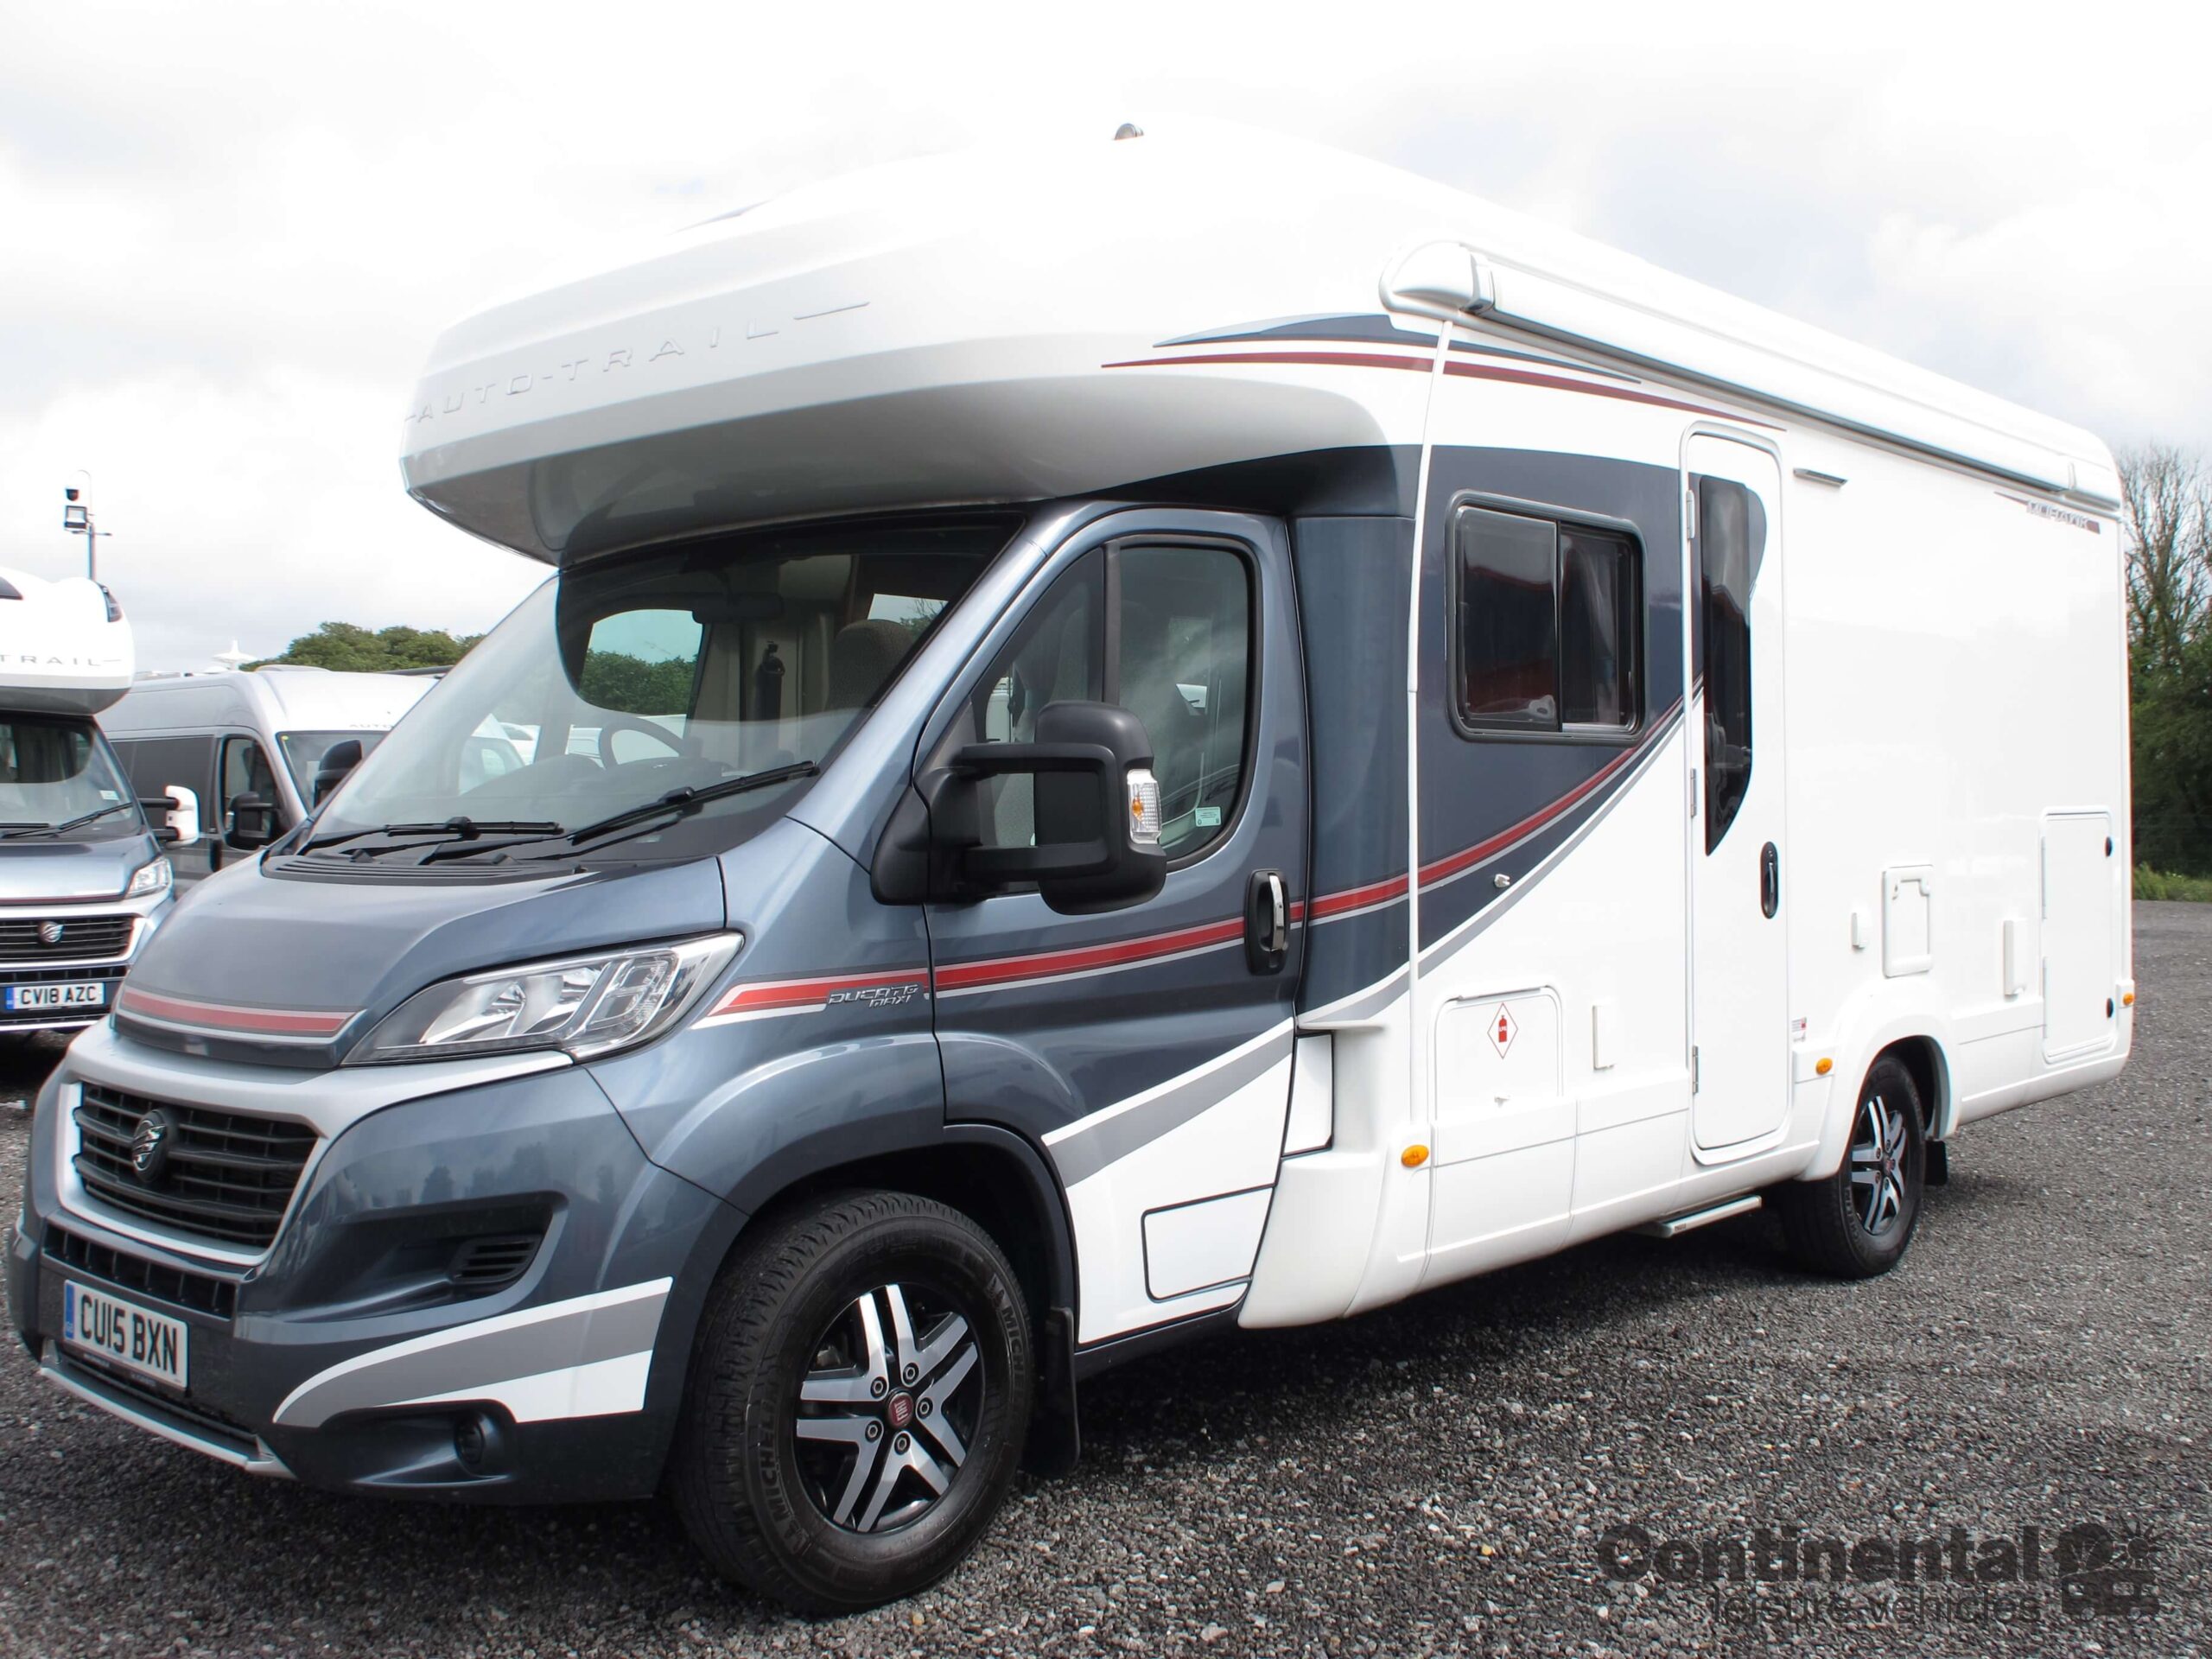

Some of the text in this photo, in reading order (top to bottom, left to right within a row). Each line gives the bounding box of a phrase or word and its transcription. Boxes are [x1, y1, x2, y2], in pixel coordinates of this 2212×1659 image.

[416, 317, 779, 423] AUTO-TRAIL
[20, 985, 97, 1005] CV18 AZC
[829, 984, 919, 1004] DUCATO
[868, 995, 912, 1008] MAXI
[80, 1294, 177, 1375] CU15 BXN
